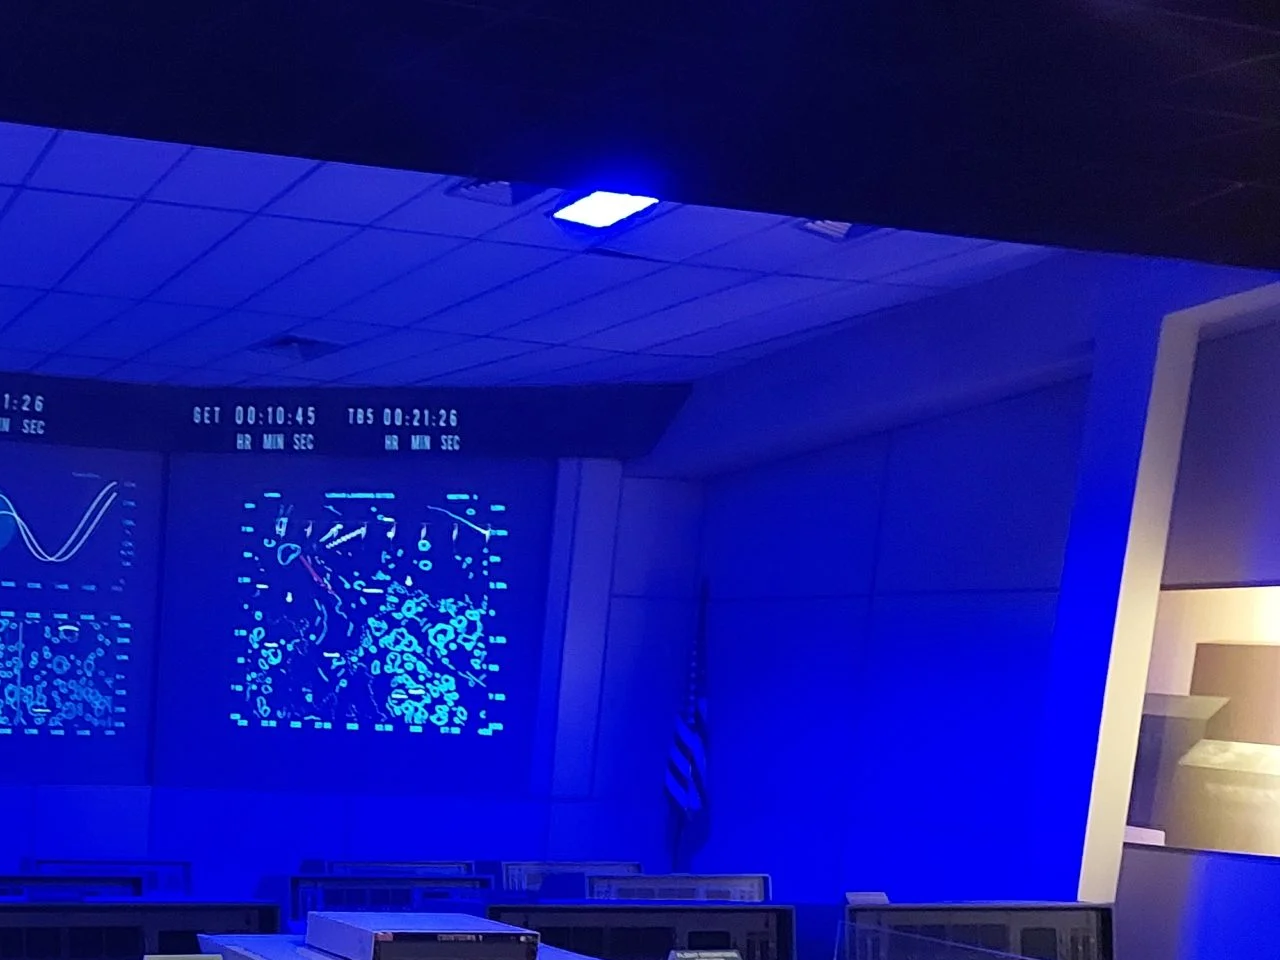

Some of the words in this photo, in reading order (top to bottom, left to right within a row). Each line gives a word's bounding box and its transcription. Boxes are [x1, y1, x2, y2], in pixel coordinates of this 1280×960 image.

[193, 406, 221, 424] GET
[235, 405, 316, 425] 00:10:45
[383, 407, 458, 427] 00:21:26
[22, 419, 46, 435] SEC
[236, 433, 252, 450] HR
[263, 433, 285, 450] MIN
[293, 433, 315, 450] SEC
[385, 434, 399, 451] HR
[411, 434, 431, 451] MIN
[440, 434, 461, 451] SEC
